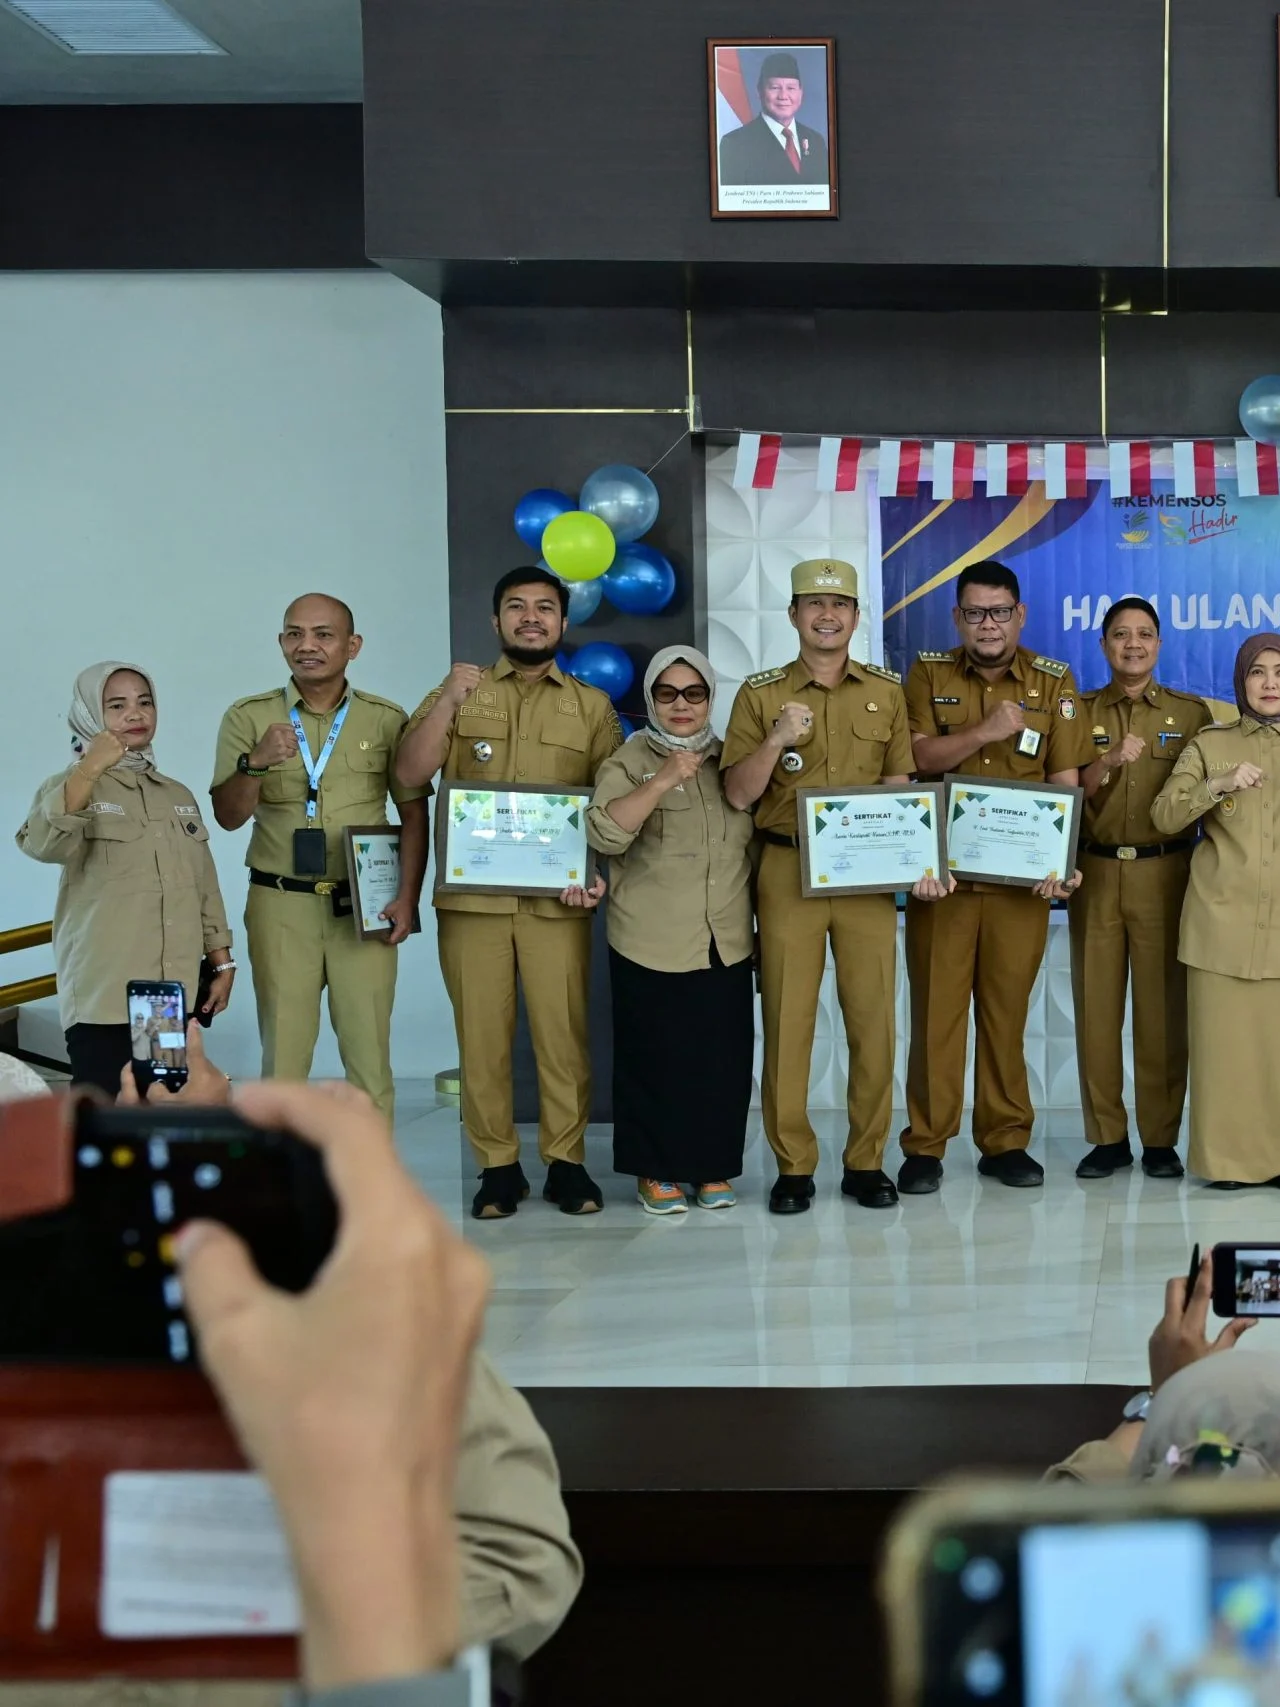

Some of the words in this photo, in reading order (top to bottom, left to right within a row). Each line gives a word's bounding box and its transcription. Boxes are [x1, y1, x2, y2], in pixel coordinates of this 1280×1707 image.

[1112, 494, 1227, 508] #KEMENSOS
[1188, 508, 1239, 537] Hadir
[1063, 593, 1157, 631] HA
[854, 812, 892, 820] SERTIFIKAT
[991, 807, 1028, 817] SERTIFIKAT
